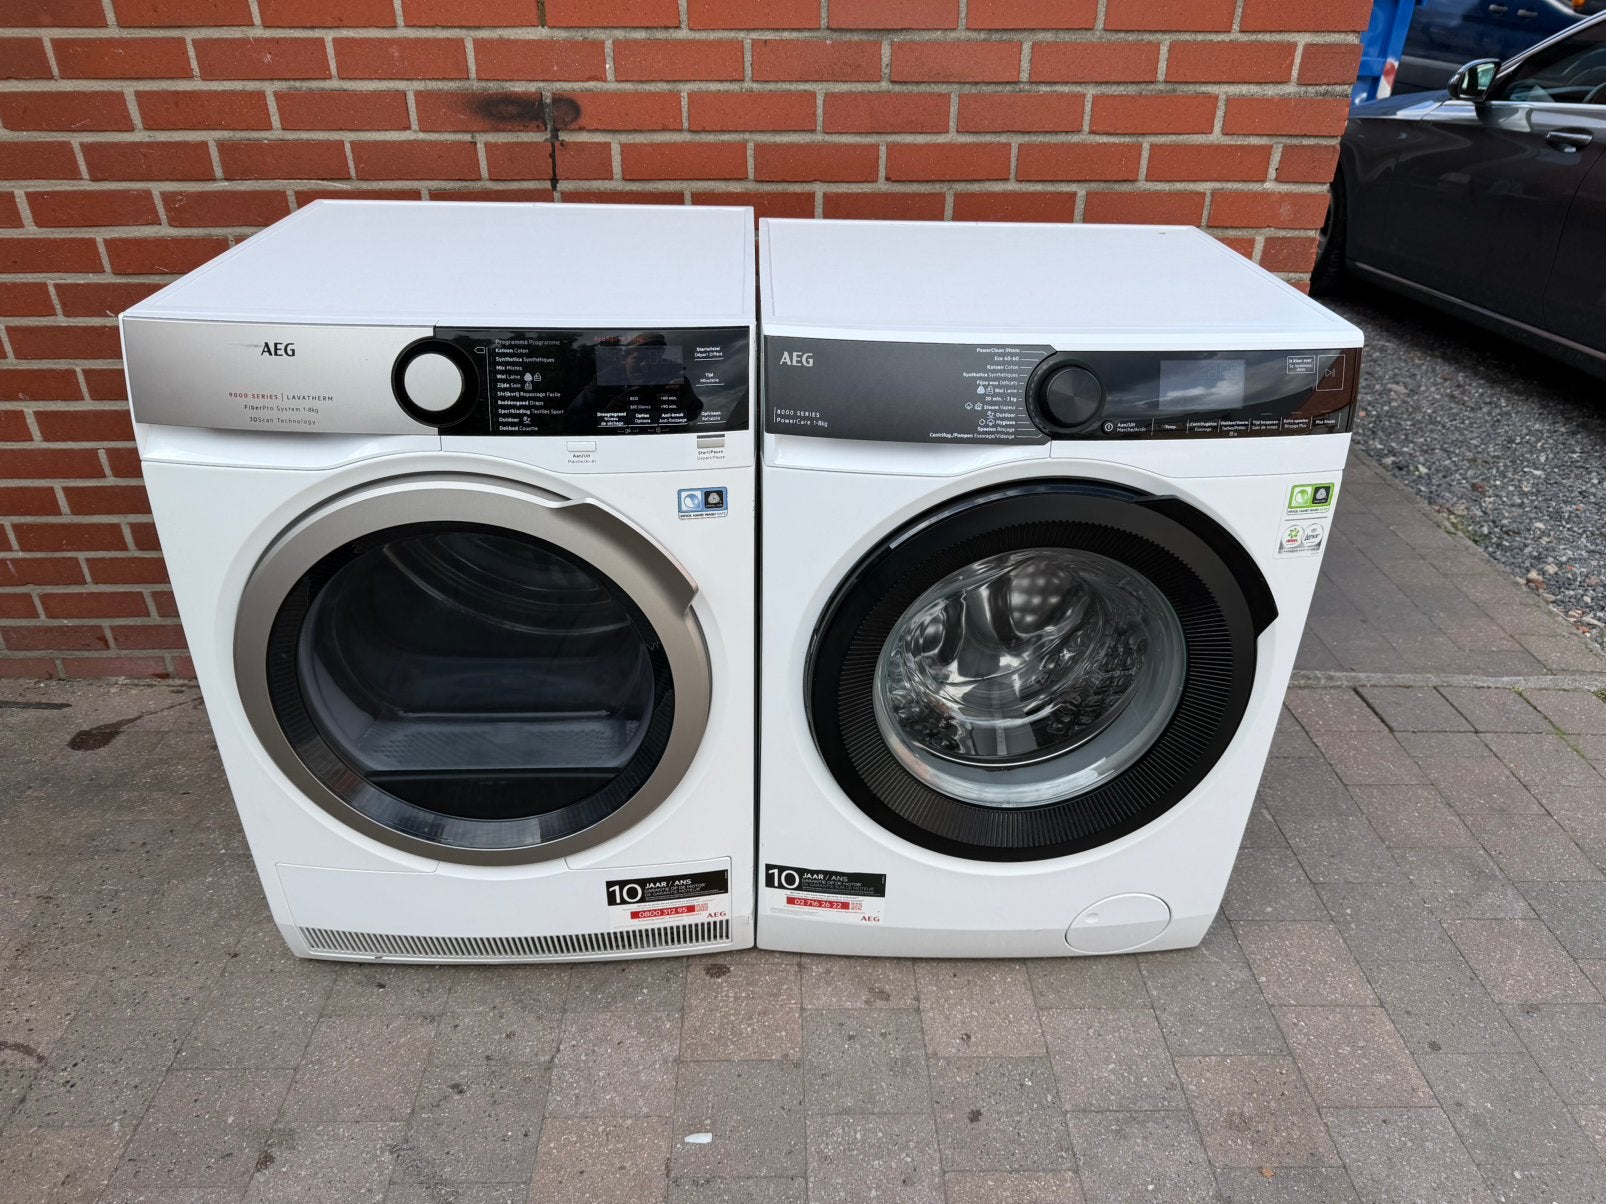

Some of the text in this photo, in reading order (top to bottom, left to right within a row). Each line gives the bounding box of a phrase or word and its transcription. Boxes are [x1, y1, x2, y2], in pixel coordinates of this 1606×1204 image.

[260, 341, 296, 358] AEG
[779, 351, 814, 367] AEG
[286, 394, 334, 402] LAVATHERM
[277, 417, 316, 426] Technology
[776, 417, 811, 425] PowerCare
[644, 880, 668, 889] JAAR
[674, 878, 692, 886] ANS
[768, 869, 800, 889] 10
[608, 883, 643, 904] 10
[652, 889, 678, 897] GARANTIE
[639, 910, 661, 918] 0800
[663, 908, 676, 916] 312
[706, 911, 727, 919] AEG
[860, 915, 880, 923] AEG
